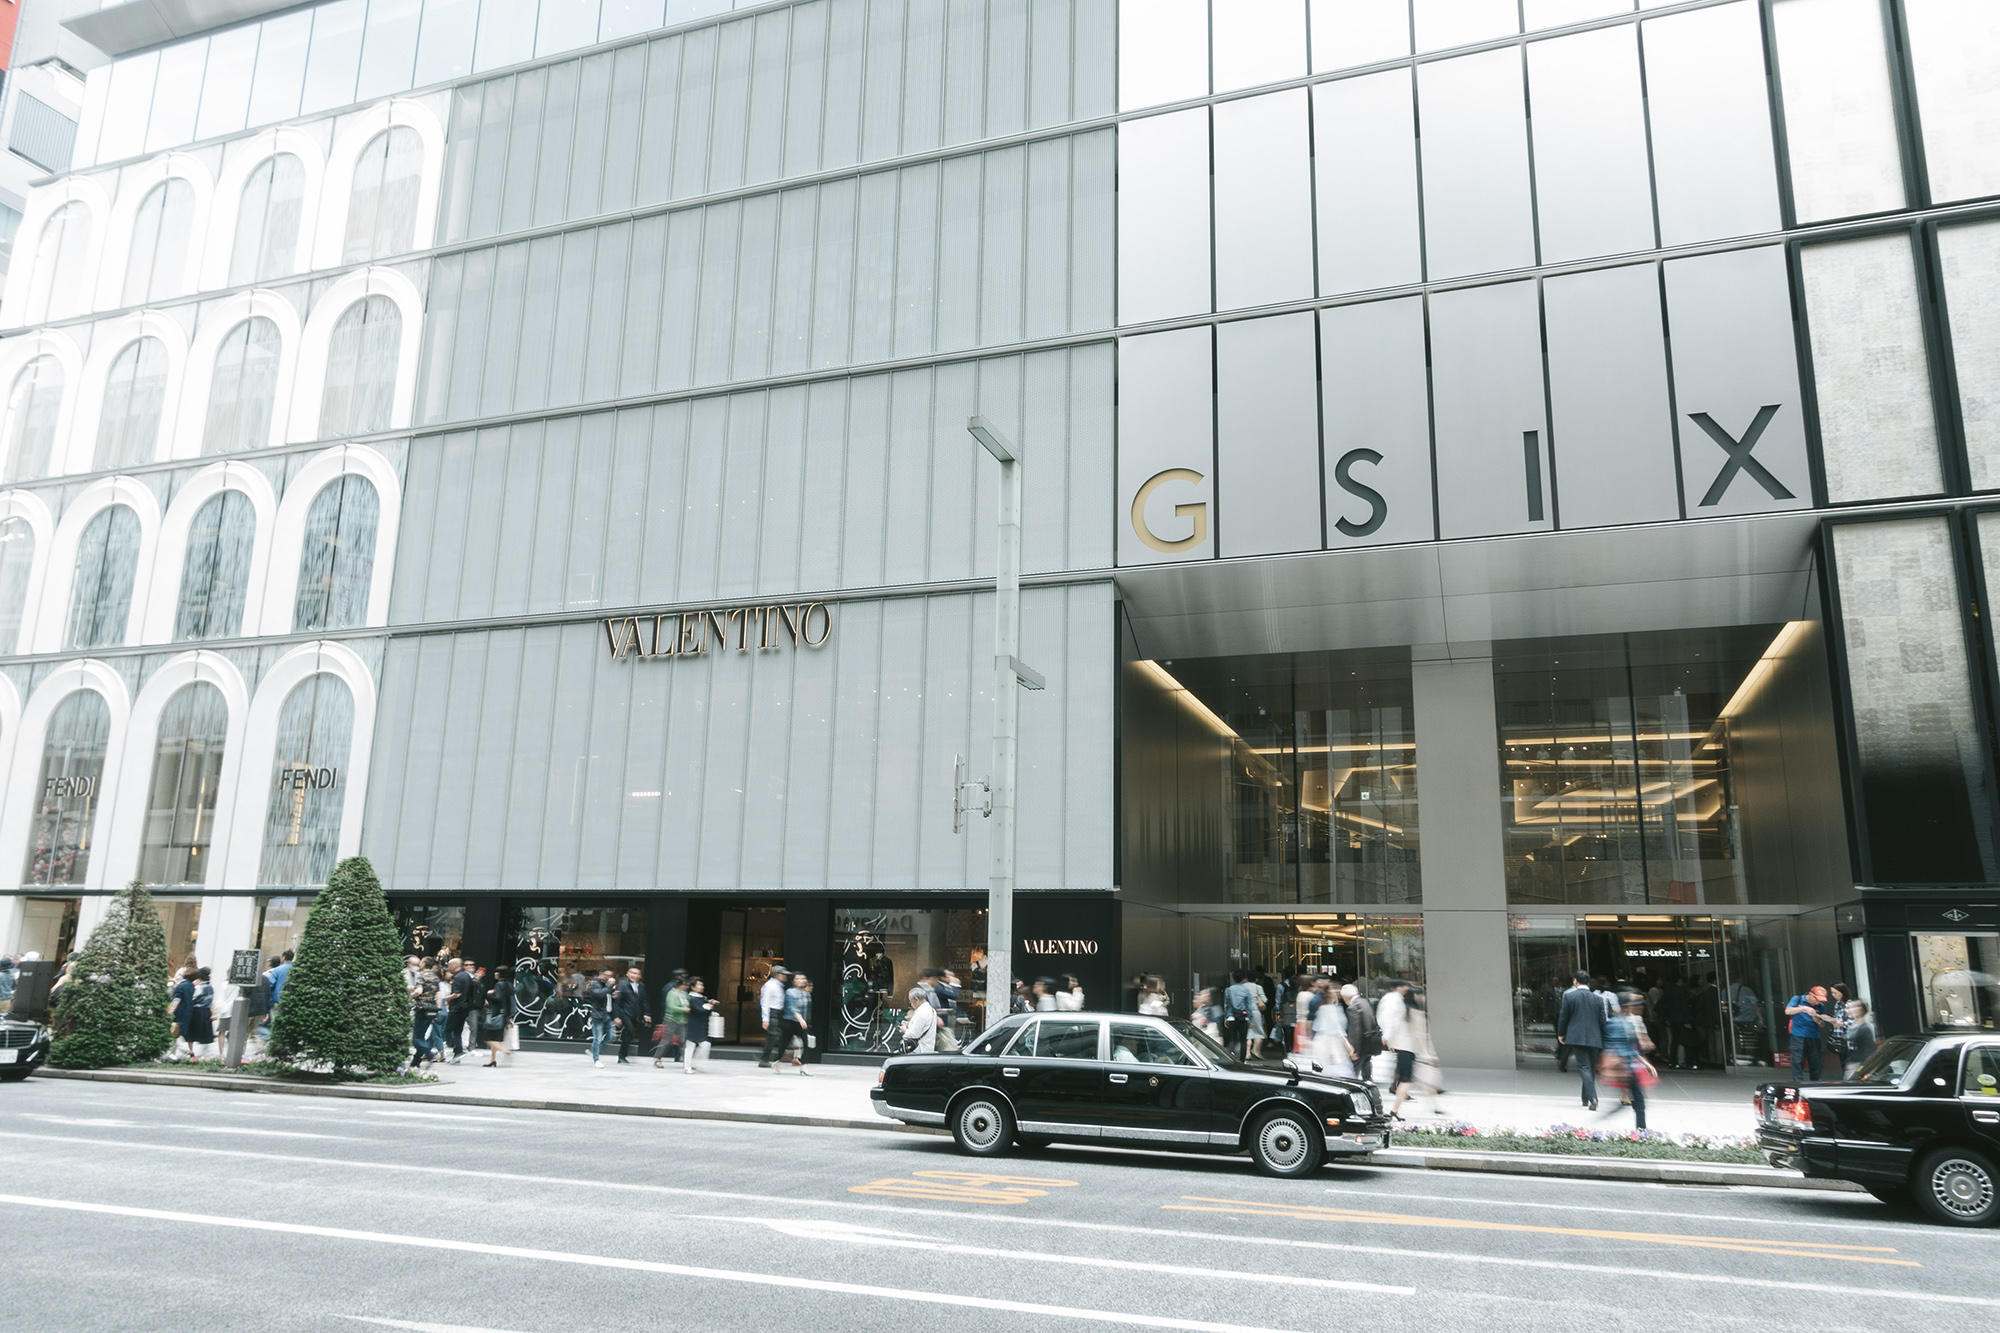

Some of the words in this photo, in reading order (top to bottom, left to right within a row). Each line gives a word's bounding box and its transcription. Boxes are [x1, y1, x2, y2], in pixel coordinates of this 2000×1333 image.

[602, 602, 832, 659] VALENTINO
[45, 776, 96, 797] FENDI
[280, 767, 338, 790] FENDI
[1024, 939, 1098, 955] VALENTINO
